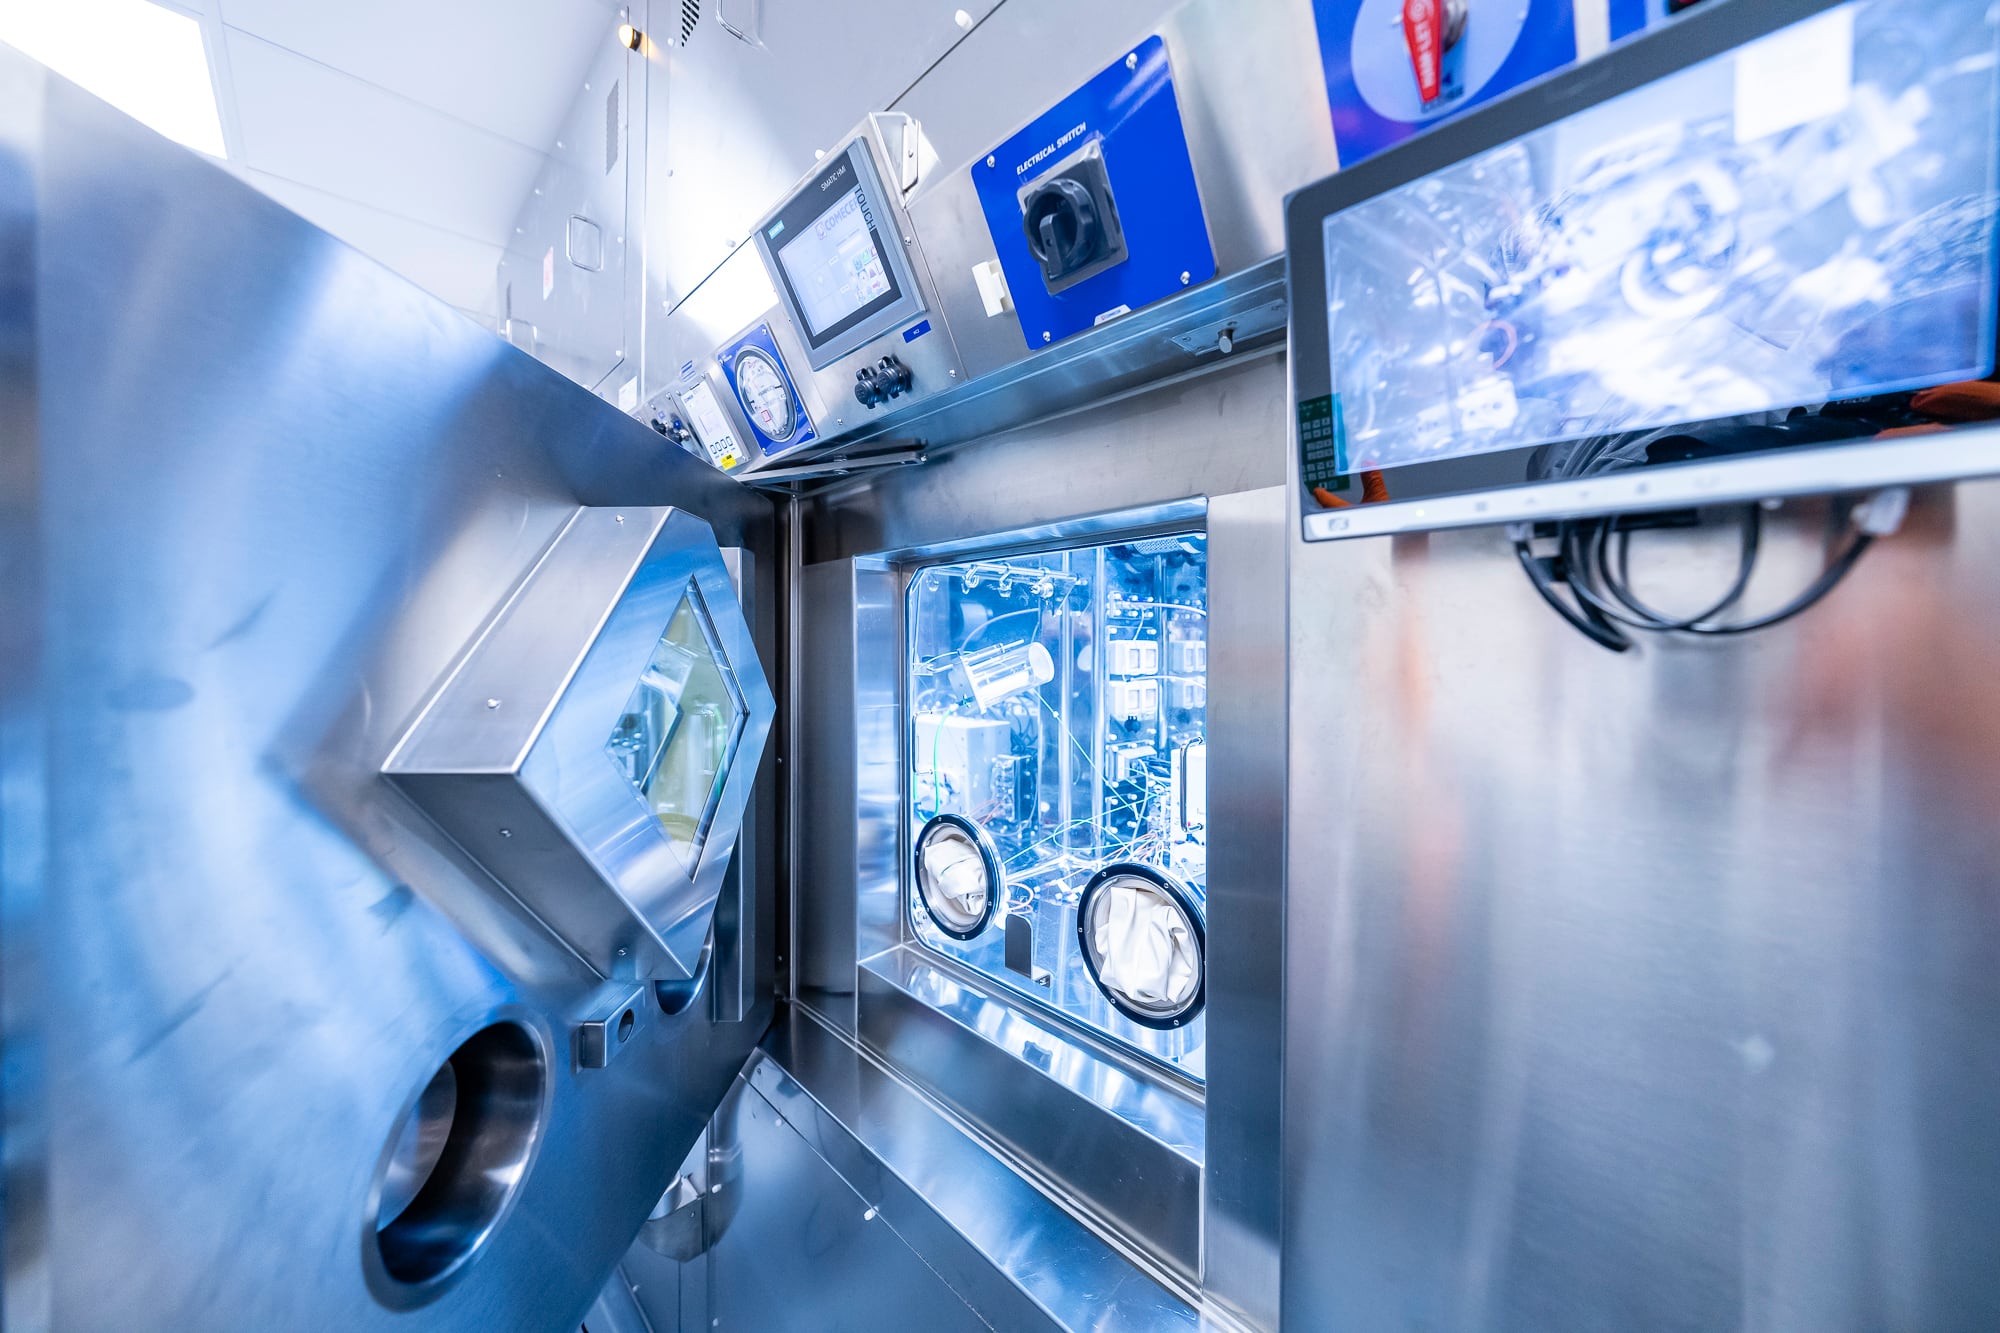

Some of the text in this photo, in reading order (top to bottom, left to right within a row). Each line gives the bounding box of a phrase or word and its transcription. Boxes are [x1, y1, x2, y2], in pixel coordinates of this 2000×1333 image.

[1016, 121, 1086, 175] ELECTRICAL SWITCH
[820, 172, 838, 192] SIMATIC
[854, 184, 876, 232] TOUCH
